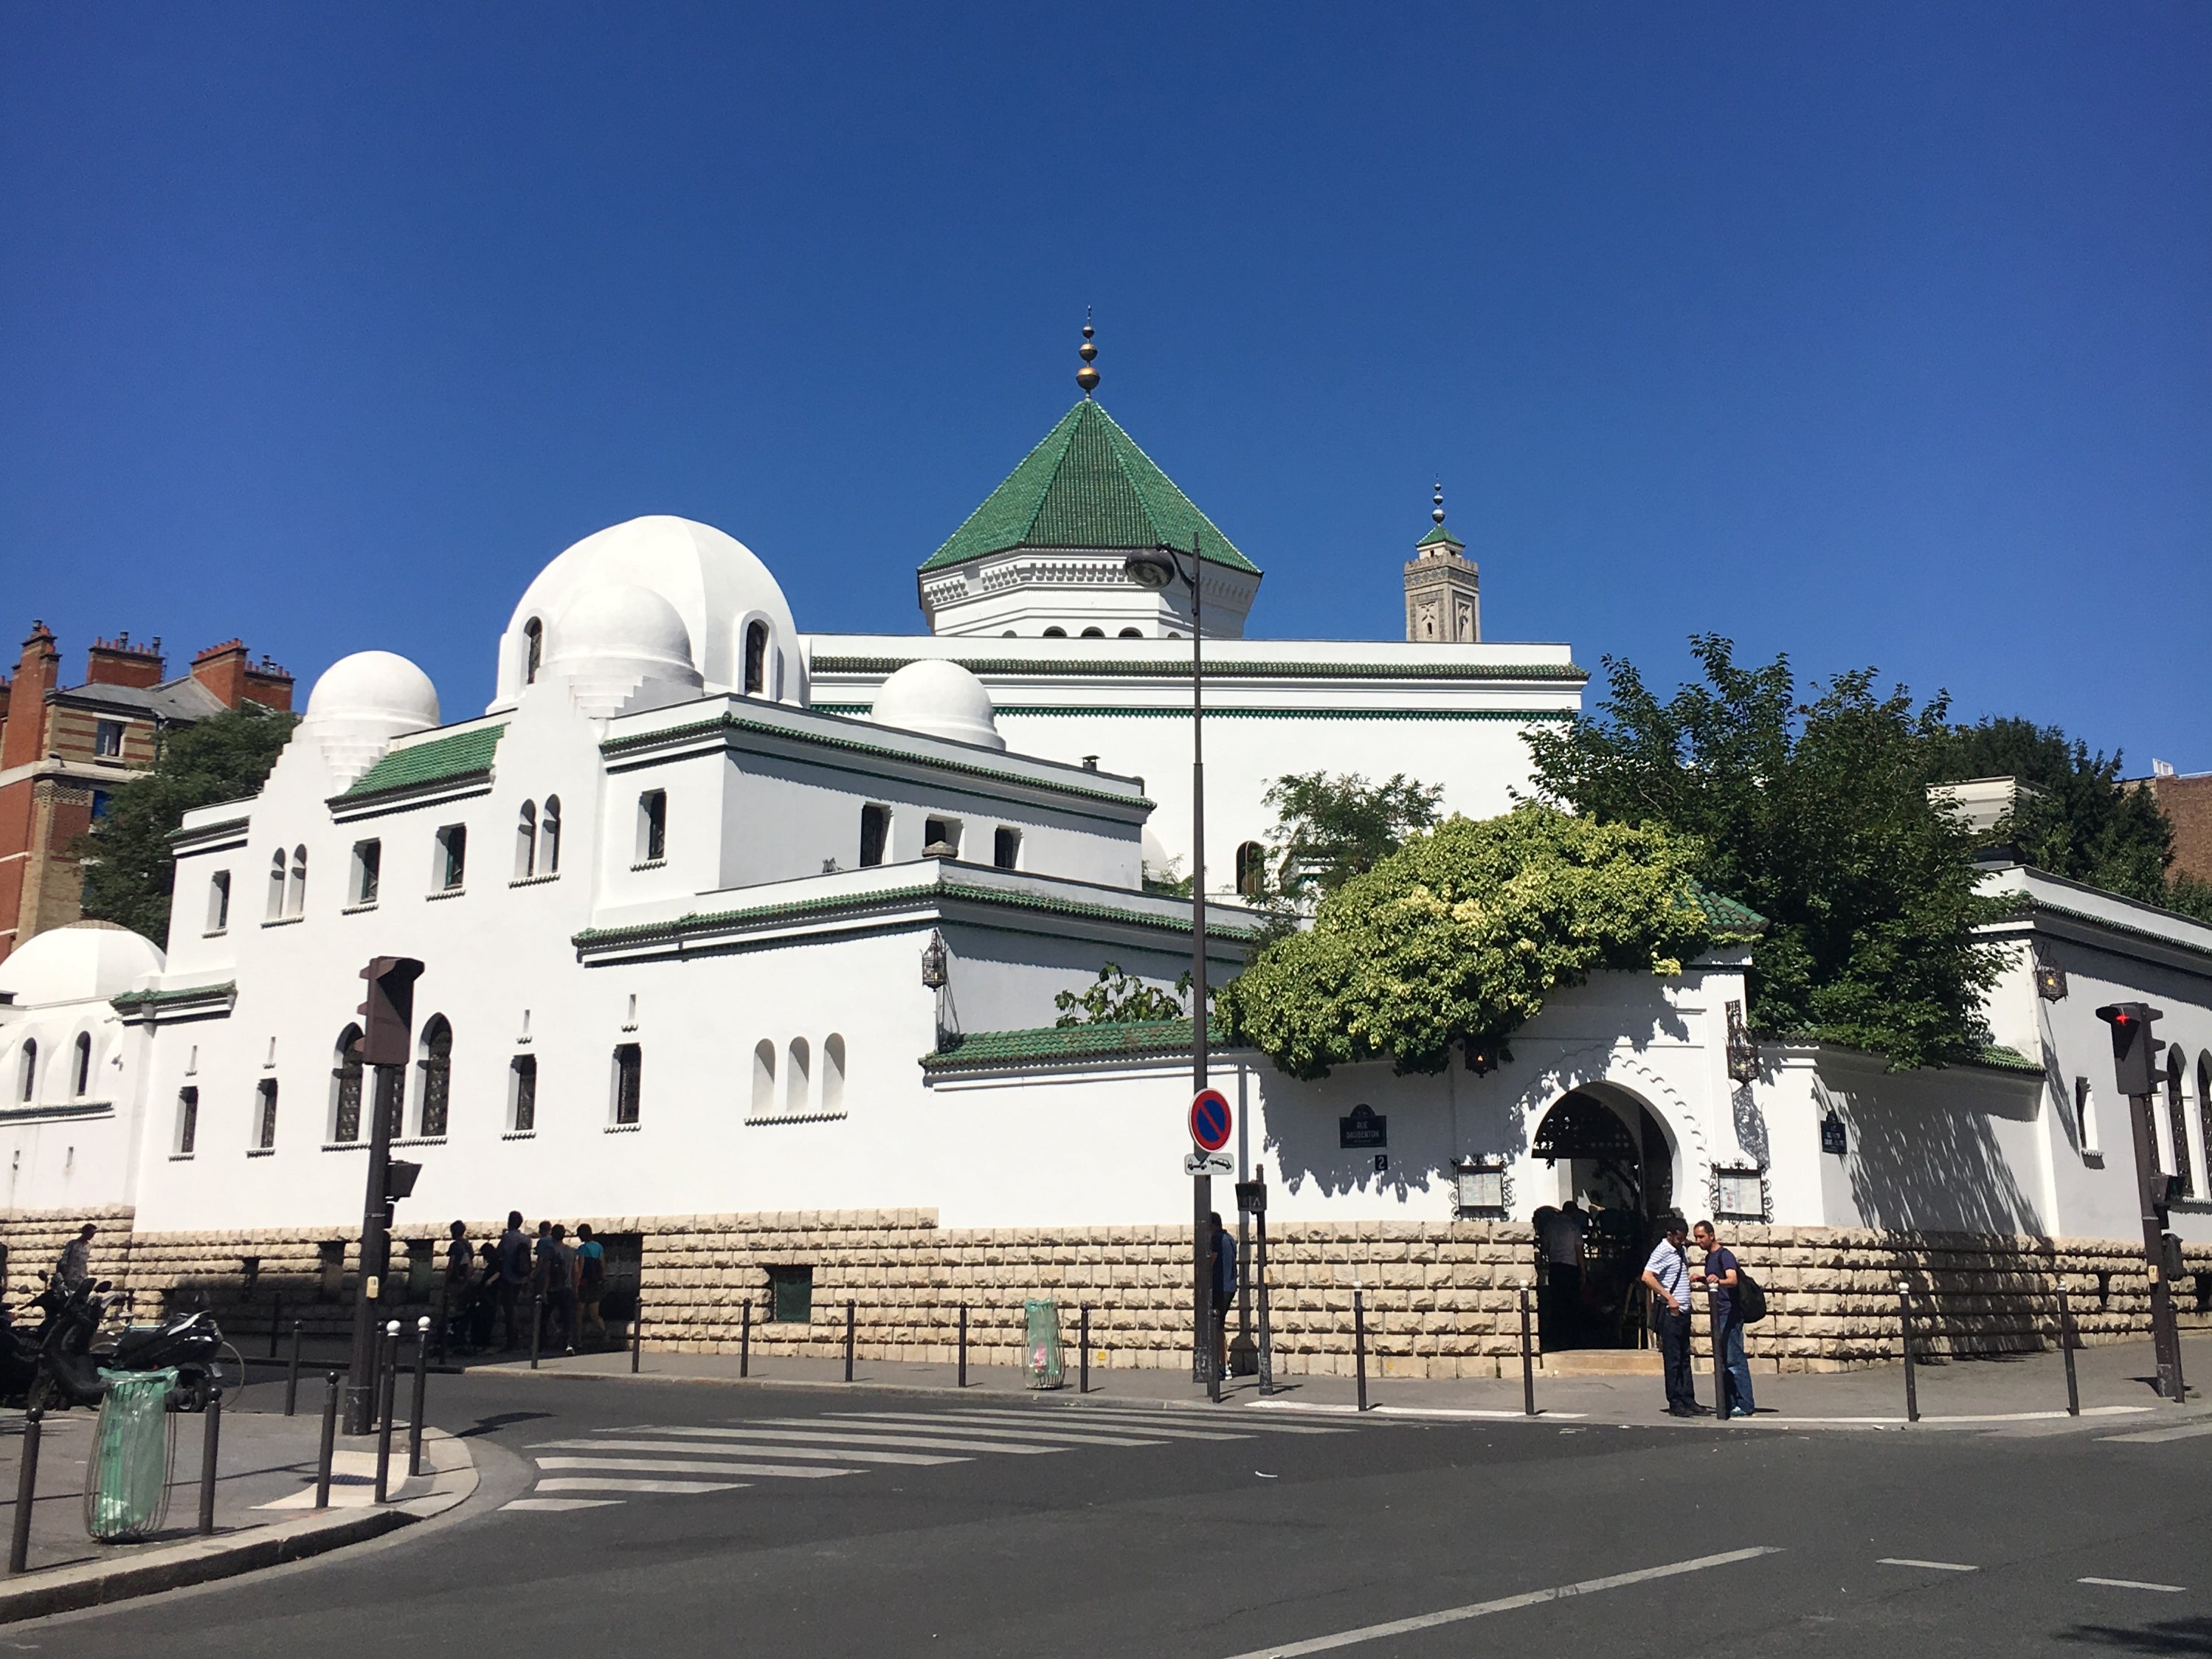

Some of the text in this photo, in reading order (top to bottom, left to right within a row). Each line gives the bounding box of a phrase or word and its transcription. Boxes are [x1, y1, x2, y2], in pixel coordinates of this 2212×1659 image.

[1356, 1121, 1368, 1129] RUE
[1346, 1130, 1380, 1139] DAUBENTON
[1378, 1156, 1385, 1170] 2
